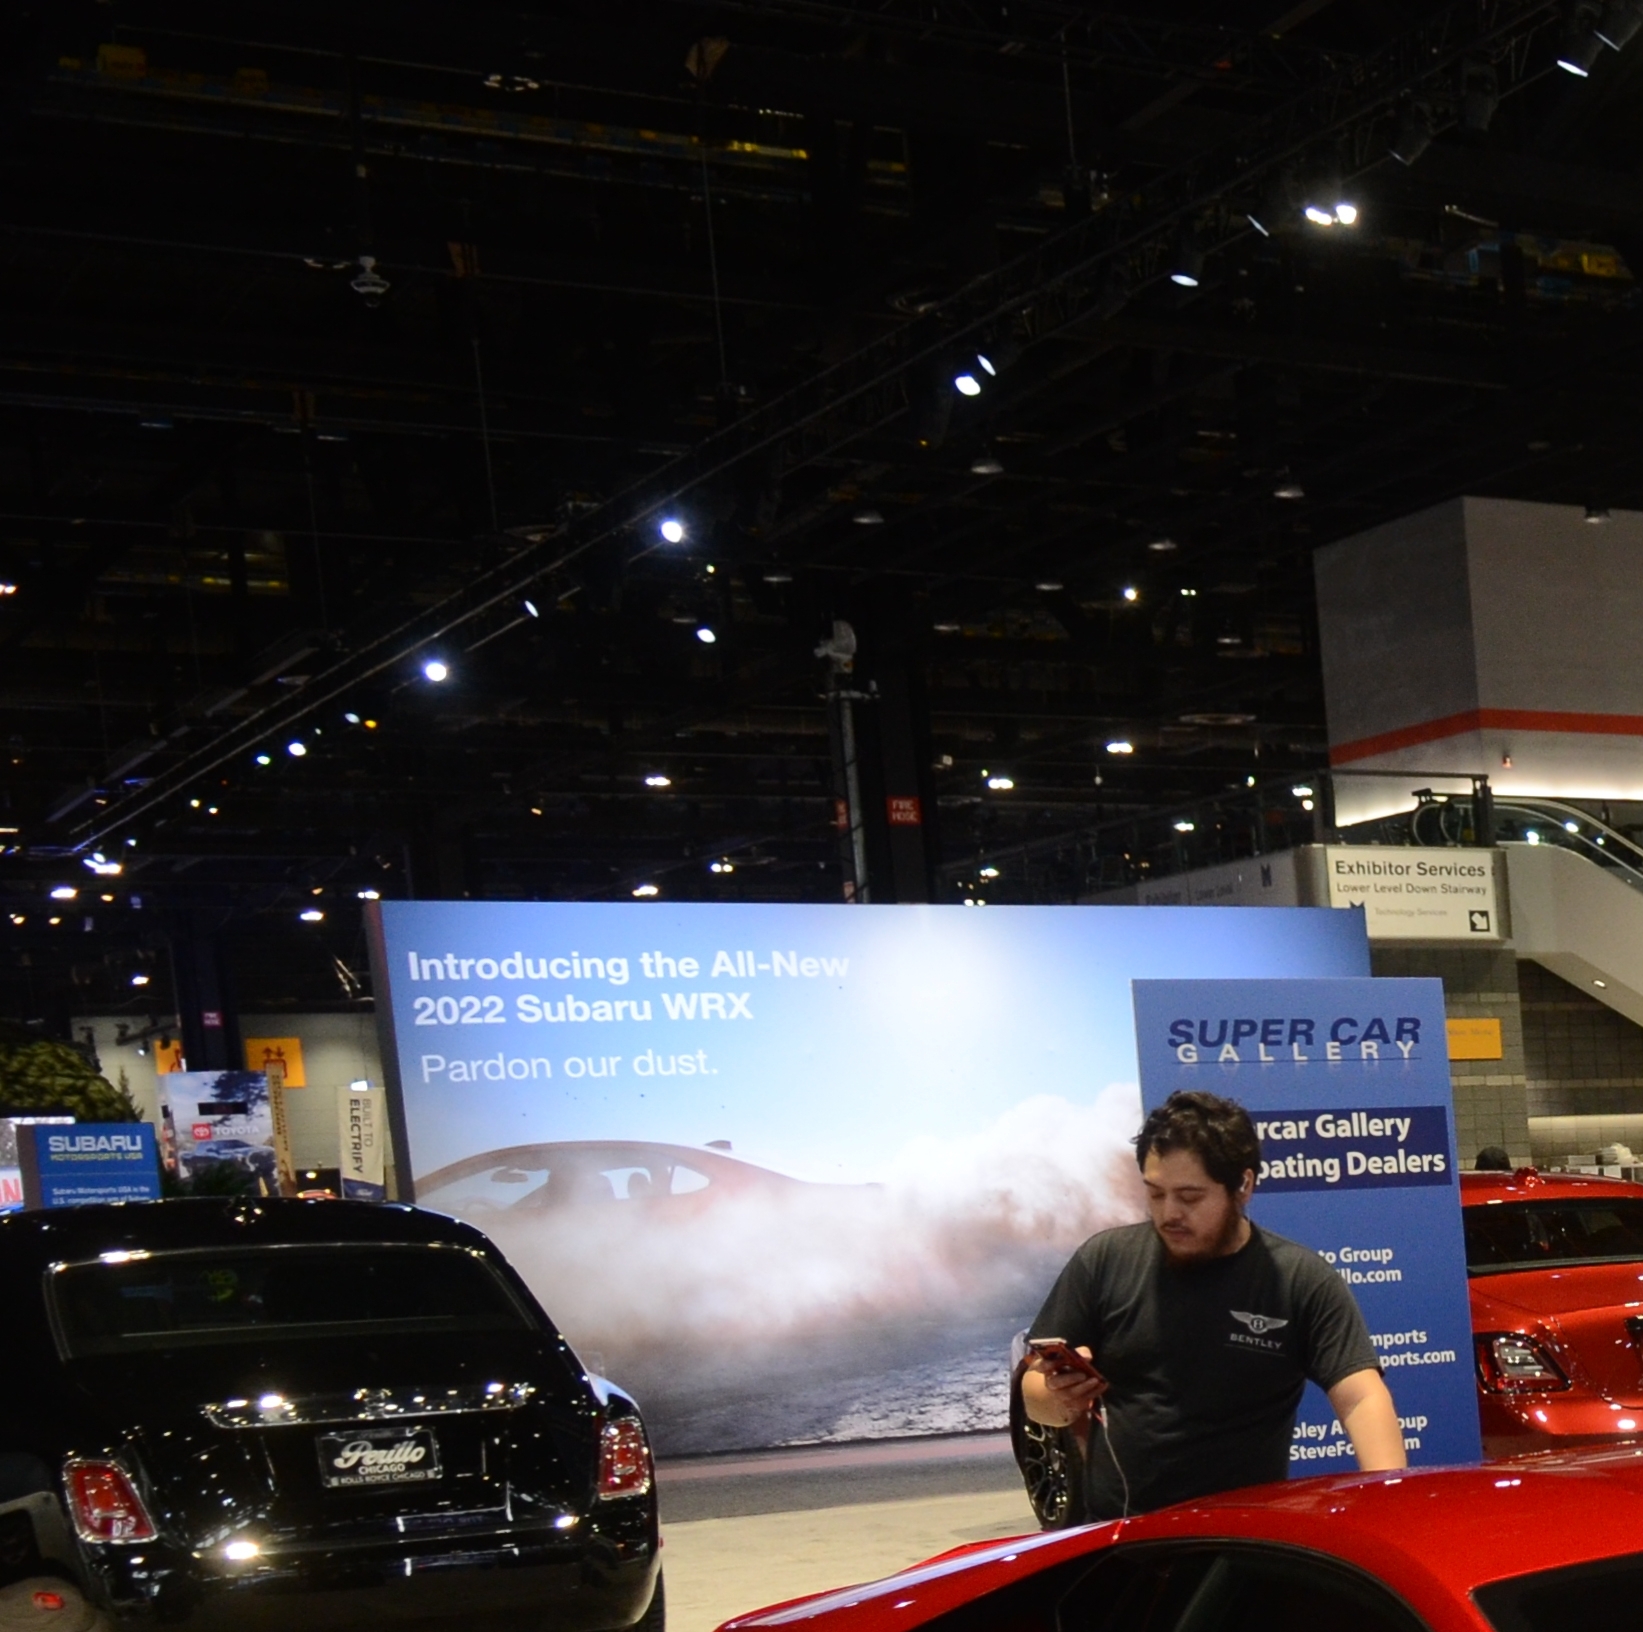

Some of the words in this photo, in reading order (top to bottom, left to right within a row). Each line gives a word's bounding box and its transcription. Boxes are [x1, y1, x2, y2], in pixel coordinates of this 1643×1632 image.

[1336, 861, 1411, 876] Exhibitor
[1417, 861, 1486, 877] Services
[1337, 883, 1370, 894] Lower
[1374, 883, 1402, 894] Level
[1406, 883, 1436, 894] Down
[1441, 884, 1487, 896] Stairway
[408, 952, 629, 984] Introducing
[641, 951, 700, 978] the
[711, 951, 849, 978] All-New
[414, 995, 506, 1025] 2022
[517, 993, 652, 1023] Subaru
[662, 992, 753, 1020] WRX
[1168, 1019, 1315, 1048] SUPER
[1330, 1017, 1421, 1046] CAR
[1177, 1041, 1415, 1063] GALLERY
[421, 1053, 551, 1083] Pardon
[563, 1056, 621, 1079] our
[633, 1049, 718, 1077] dust.
[363, 1098, 373, 1128] BUILT
[215, 1126, 260, 1136] TOYOTA
[350, 1098, 363, 1173] ELECTRIFY
[1256, 1120, 1310, 1140] rcar
[1315, 1112, 1411, 1142] Gallery
[48, 1135, 142, 1152] SUBARU
[364, 1133, 373, 1147] TO
[1257, 1153, 1341, 1185] pating
[1347, 1149, 1446, 1176] Dealers
[1340, 1247, 1393, 1264] Group
[1230, 1333, 1282, 1349] BENTLEY
[1369, 1330, 1427, 1348] mports
[1380, 1350, 1456, 1369] ports.com
[333, 1441, 426, 1468] Perillo
[358, 1463, 405, 1475] CHICAGO
